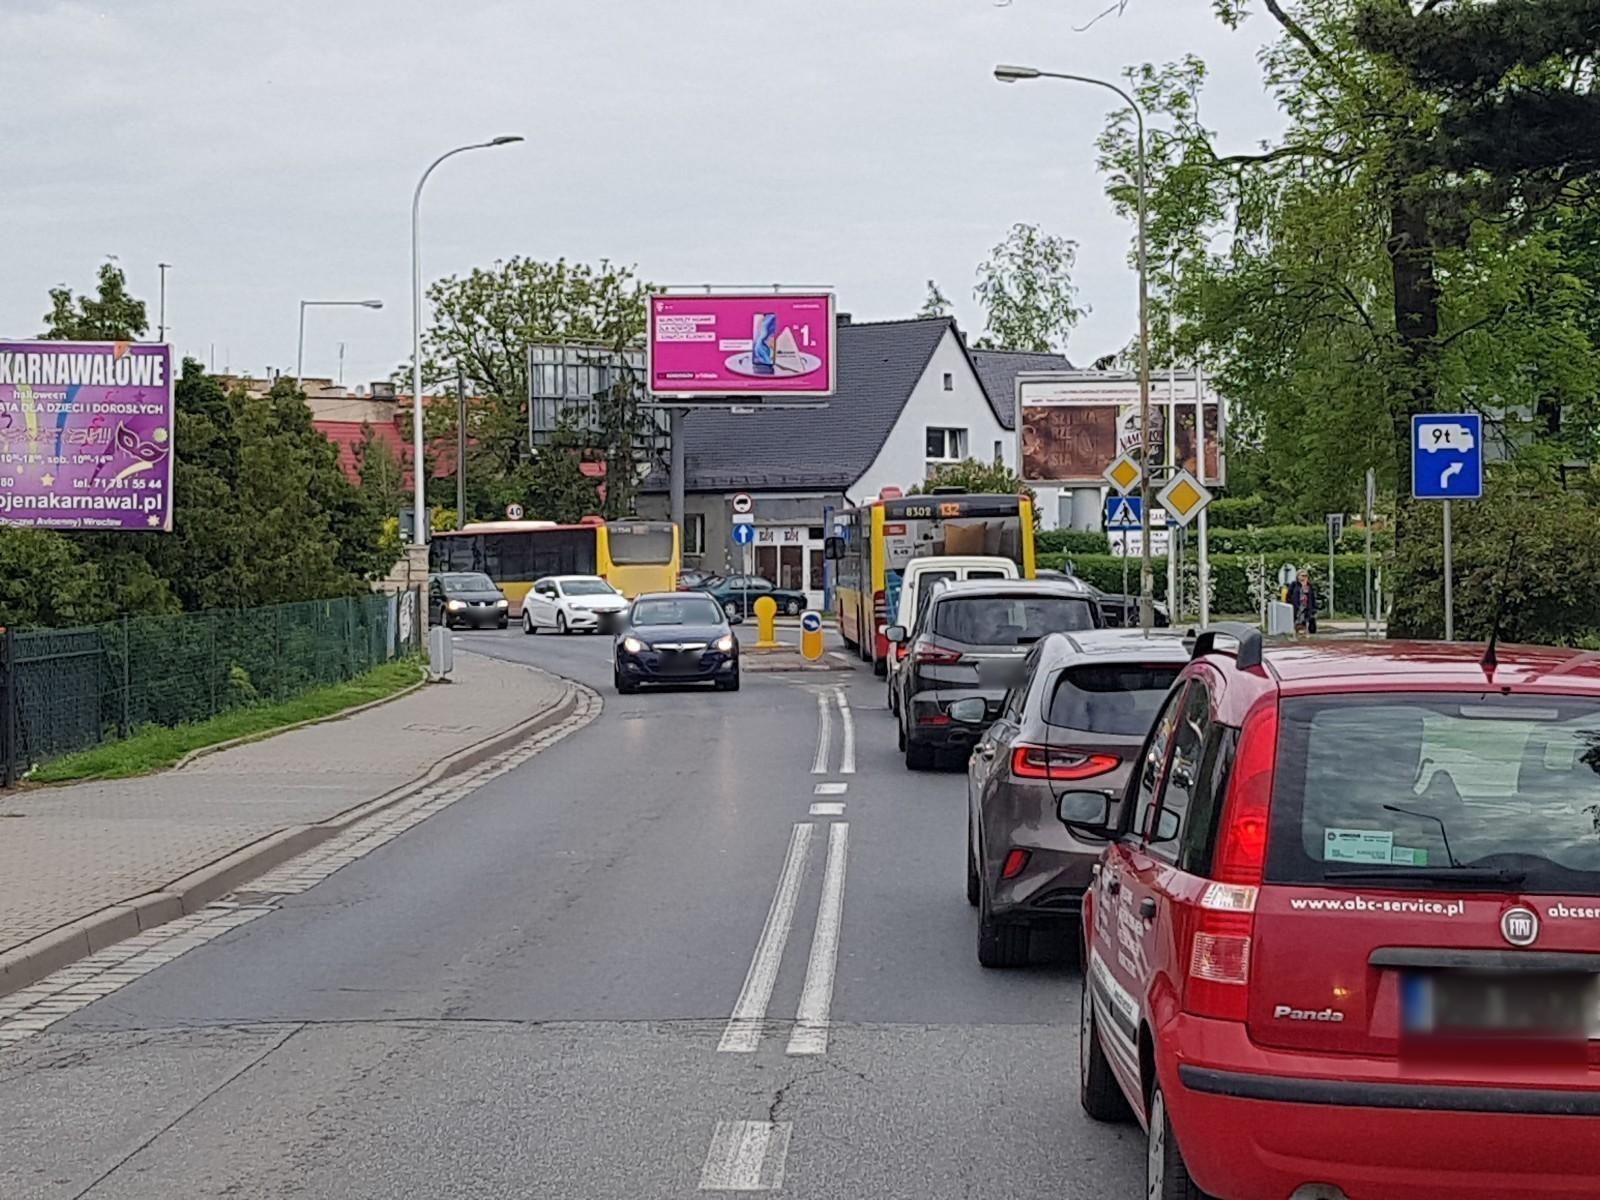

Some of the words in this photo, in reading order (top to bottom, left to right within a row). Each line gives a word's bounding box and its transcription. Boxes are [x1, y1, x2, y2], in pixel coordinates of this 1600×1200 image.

[21, 402, 44, 413] DLA
[47, 402, 85, 414] DZIECI
[92, 402, 164, 415] DOROSŁYCH
[73, 478, 90, 488] tel.
[132, 480, 146, 489] 55
[509, 507, 521, 516] 40
[1290, 897, 1464, 917] www.abc-service.pl
[1509, 917, 1532, 936] FIAT
[1273, 1005, 1344, 1022] Panda
